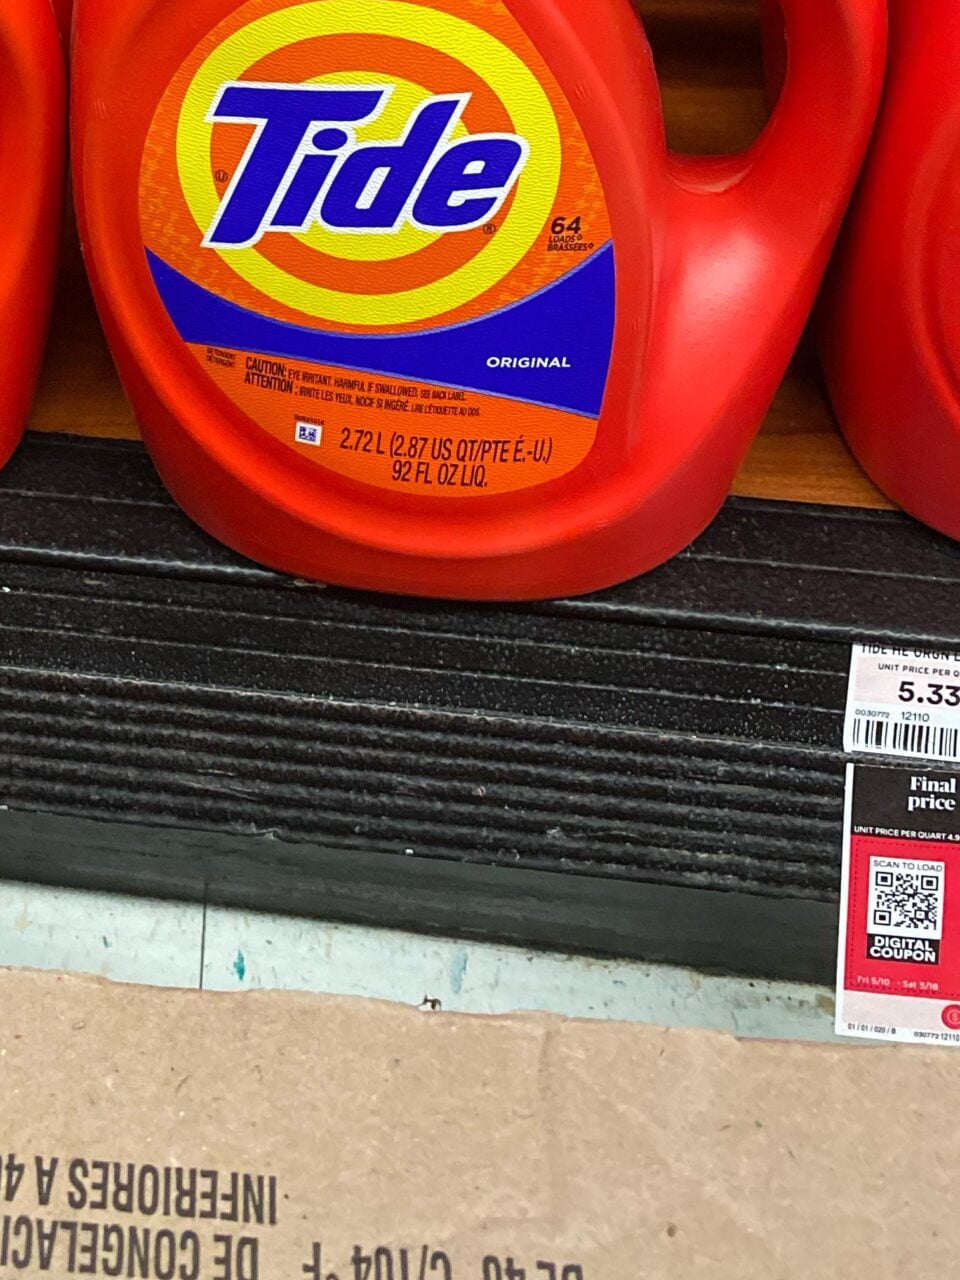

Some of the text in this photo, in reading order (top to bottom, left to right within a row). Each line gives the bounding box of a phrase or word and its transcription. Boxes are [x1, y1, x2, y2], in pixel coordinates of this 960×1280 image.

[200, 80, 530, 249] Tide
[550, 216, 582, 235] 64
[245, 356, 287, 378] CAUTION:
[288, 369, 301, 381] EYE
[486, 356, 571, 369] ORIGINAL
[244, 371, 294, 394] ATTENTION
[340, 427, 553, 464] 2.72 L (2.87 US QT/PTE É.-U.)
[392, 460, 488, 488] 92 FL OZ LIQ.
[878, 663, 900, 672] UNIT
[902, 665, 930, 675] PRICE
[932, 668, 951, 677] PER
[898, 680, 960, 707] 5.33
[900, 711, 930, 722] 12110
[910, 775, 957, 794] Final
[907, 794, 957, 812] price
[853, 825, 946, 840] UNIT PRICE PER QUART
[873, 859, 943, 872] SCAN TO LOAD
[874, 936, 933, 951] DIGITAL
[869, 947, 936, 962] COUPON
[857, 975, 869, 984] Fri
[902, 980, 917, 989] Sat
[34, 1155, 60, 1207] A
[67, 1157, 279, 1227] INFERIORES
[213, 1234, 260, 1280] DE
